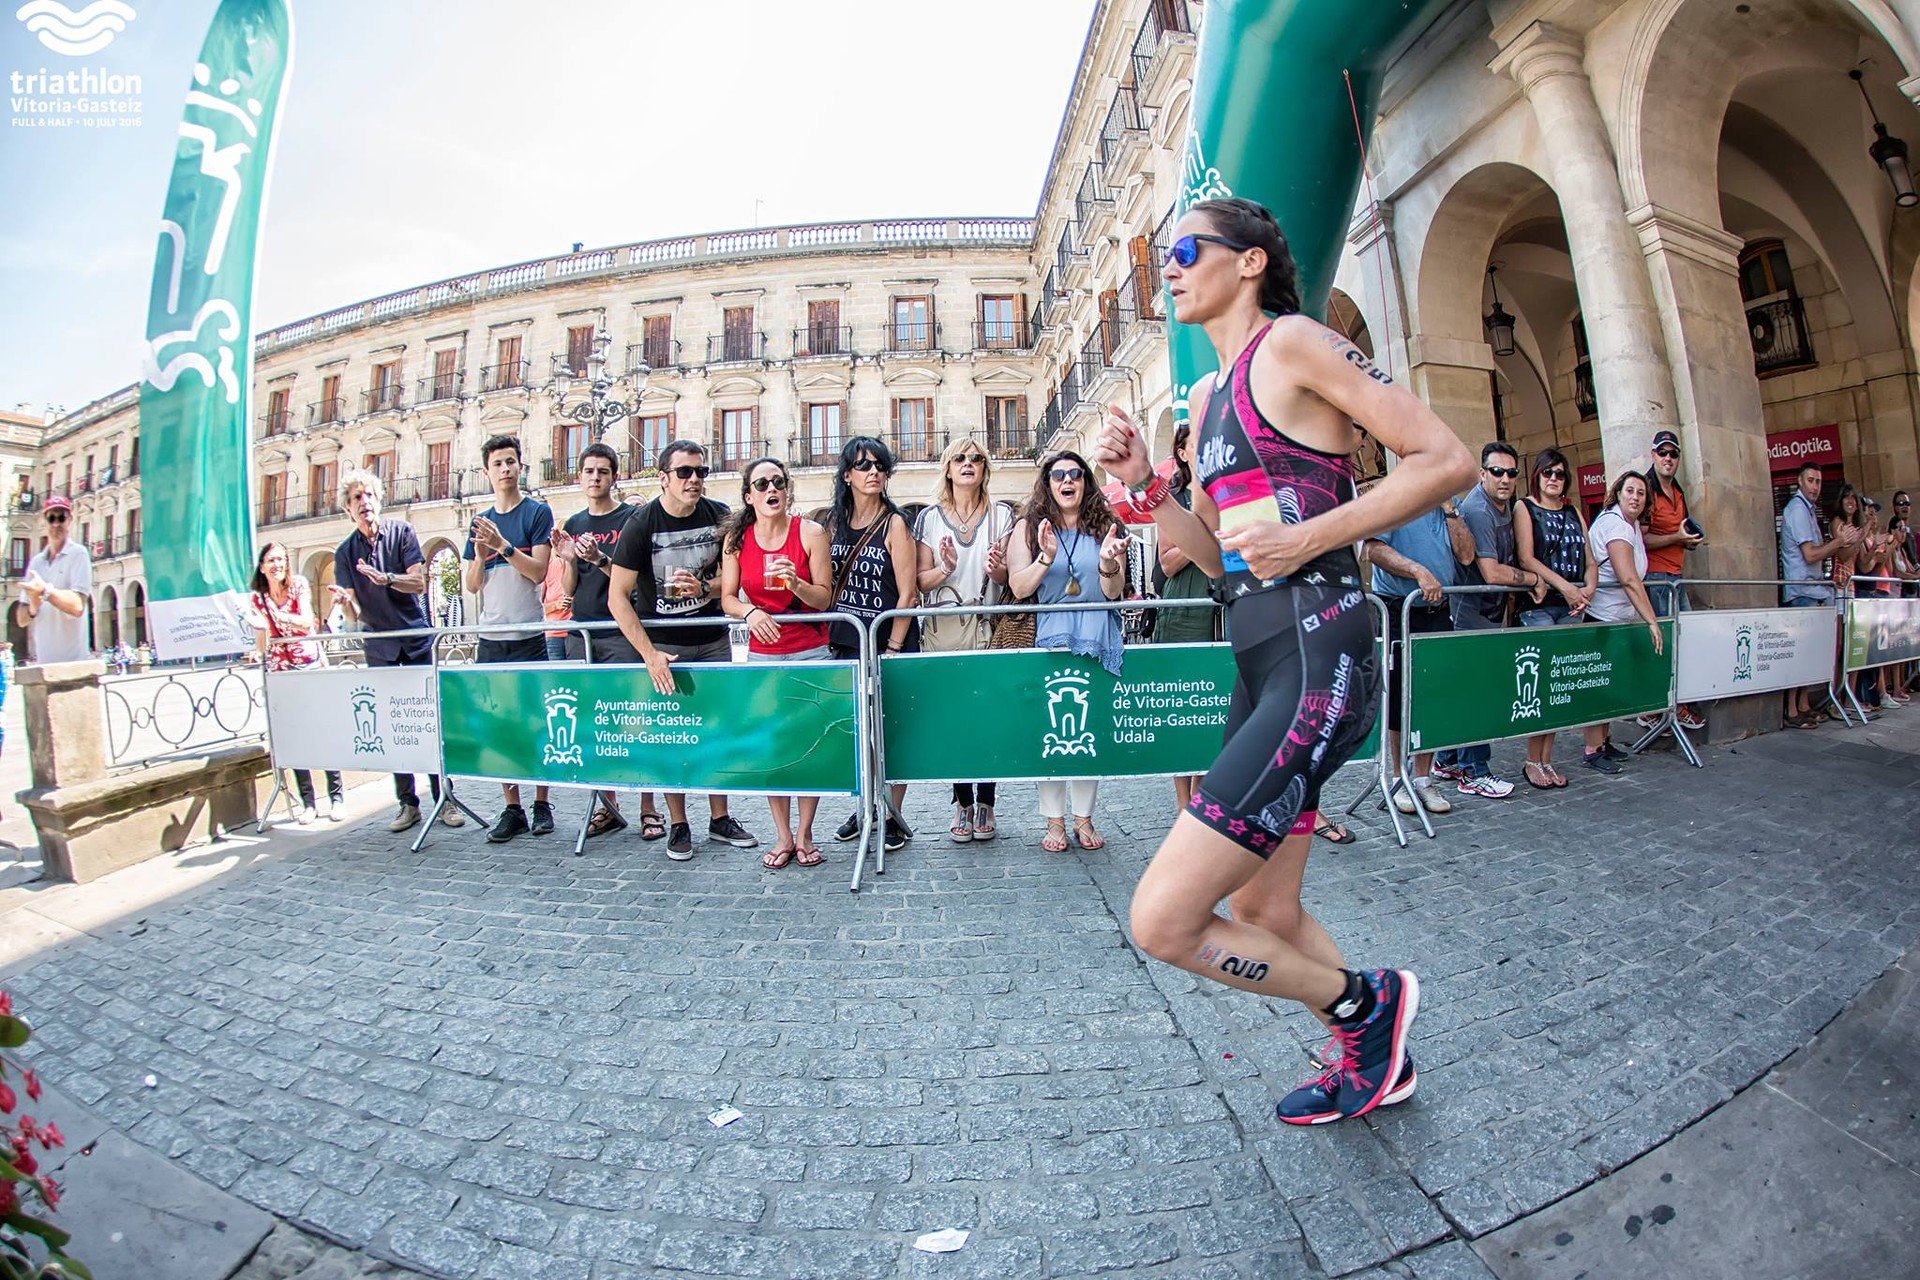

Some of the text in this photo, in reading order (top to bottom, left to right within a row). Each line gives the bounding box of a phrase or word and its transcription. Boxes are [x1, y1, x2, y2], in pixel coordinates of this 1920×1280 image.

[1767, 437, 1832, 458] ndia Optika
[853, 545, 886, 562] ORK
[839, 589, 883, 608] OKYO
[1550, 651, 1602, 667] Ayuntamiento
[1550, 661, 1612, 678] de Vitoria-Gasteiz
[1112, 680, 1215, 696] Ayuntamiento
[1549, 676, 1610, 692] Vitoria-Gasteizko
[1113, 693, 1232, 709] de Vitoria-Gastei
[1319, 653, 1351, 739] bulletbike
[1549, 693, 1571, 705] Udala
[390, 707, 434, 718] de Vitoria
[594, 699, 680, 713] Ayuntamiento
[594, 713, 703, 726] de Vitoria-Gasteiz
[391, 723, 436, 733] Vitoria-Ga
[1113, 729, 1155, 743] Udala
[393, 736, 419, 746] Udala
[594, 730, 699, 745] Vitoria-Gasteizko
[595, 745, 629, 757] Udala
[1220, 956, 1269, 981] 25
